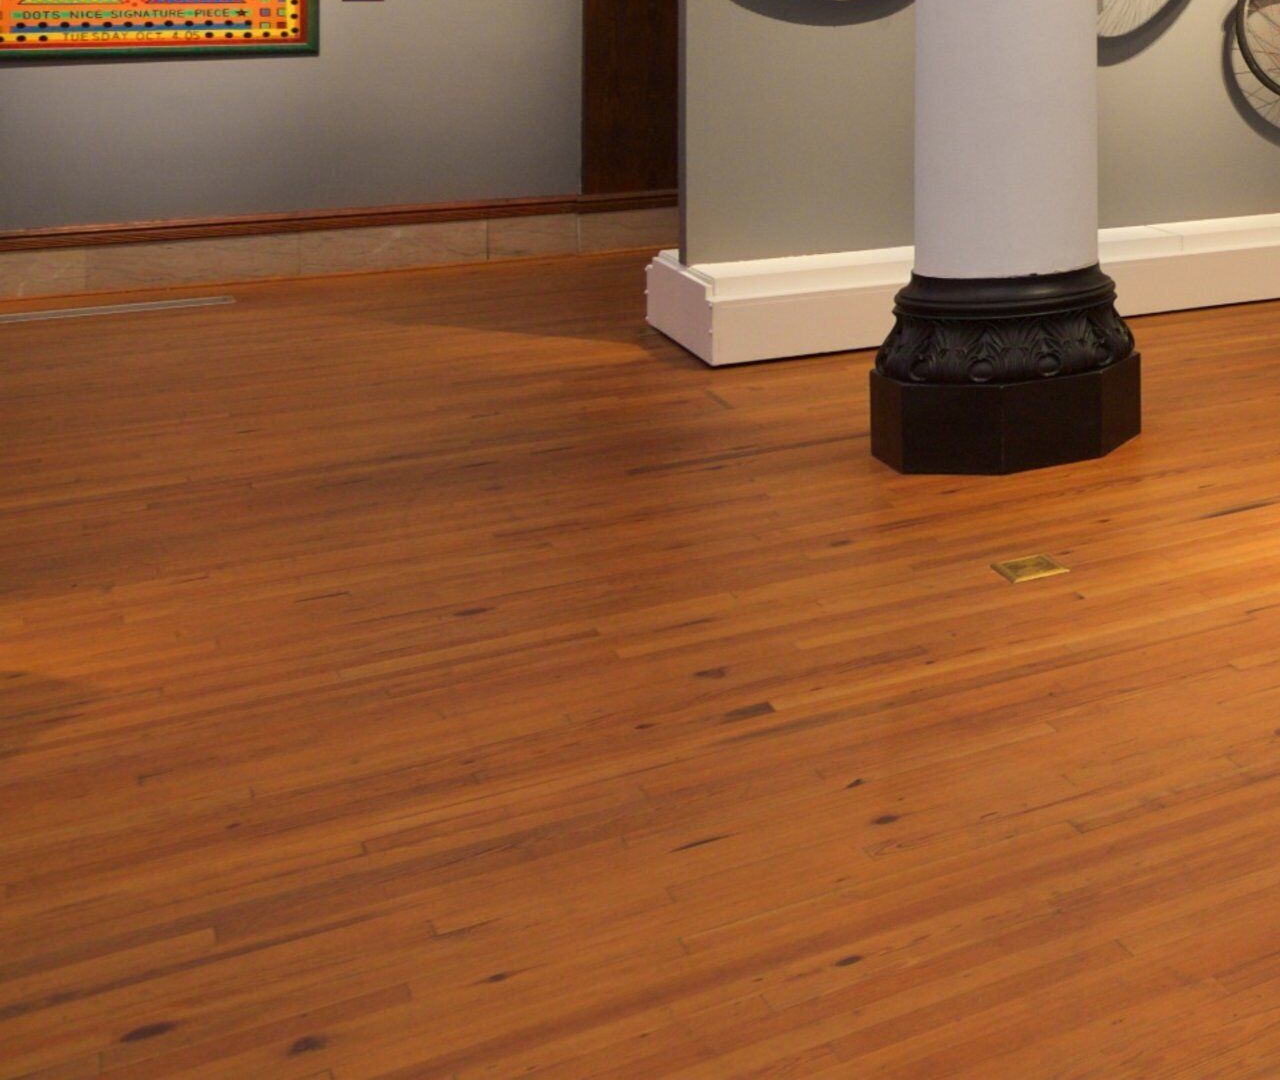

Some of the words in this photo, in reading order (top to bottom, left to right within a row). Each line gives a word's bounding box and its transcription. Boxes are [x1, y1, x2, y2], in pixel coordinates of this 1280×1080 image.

[22, 10, 61, 19] DOTS
[70, 9, 103, 19] NICE
[111, 9, 184, 19] SIGNATURE
[194, 8, 229, 18] PIECE
[63, 32, 128, 41] TUESDAY
